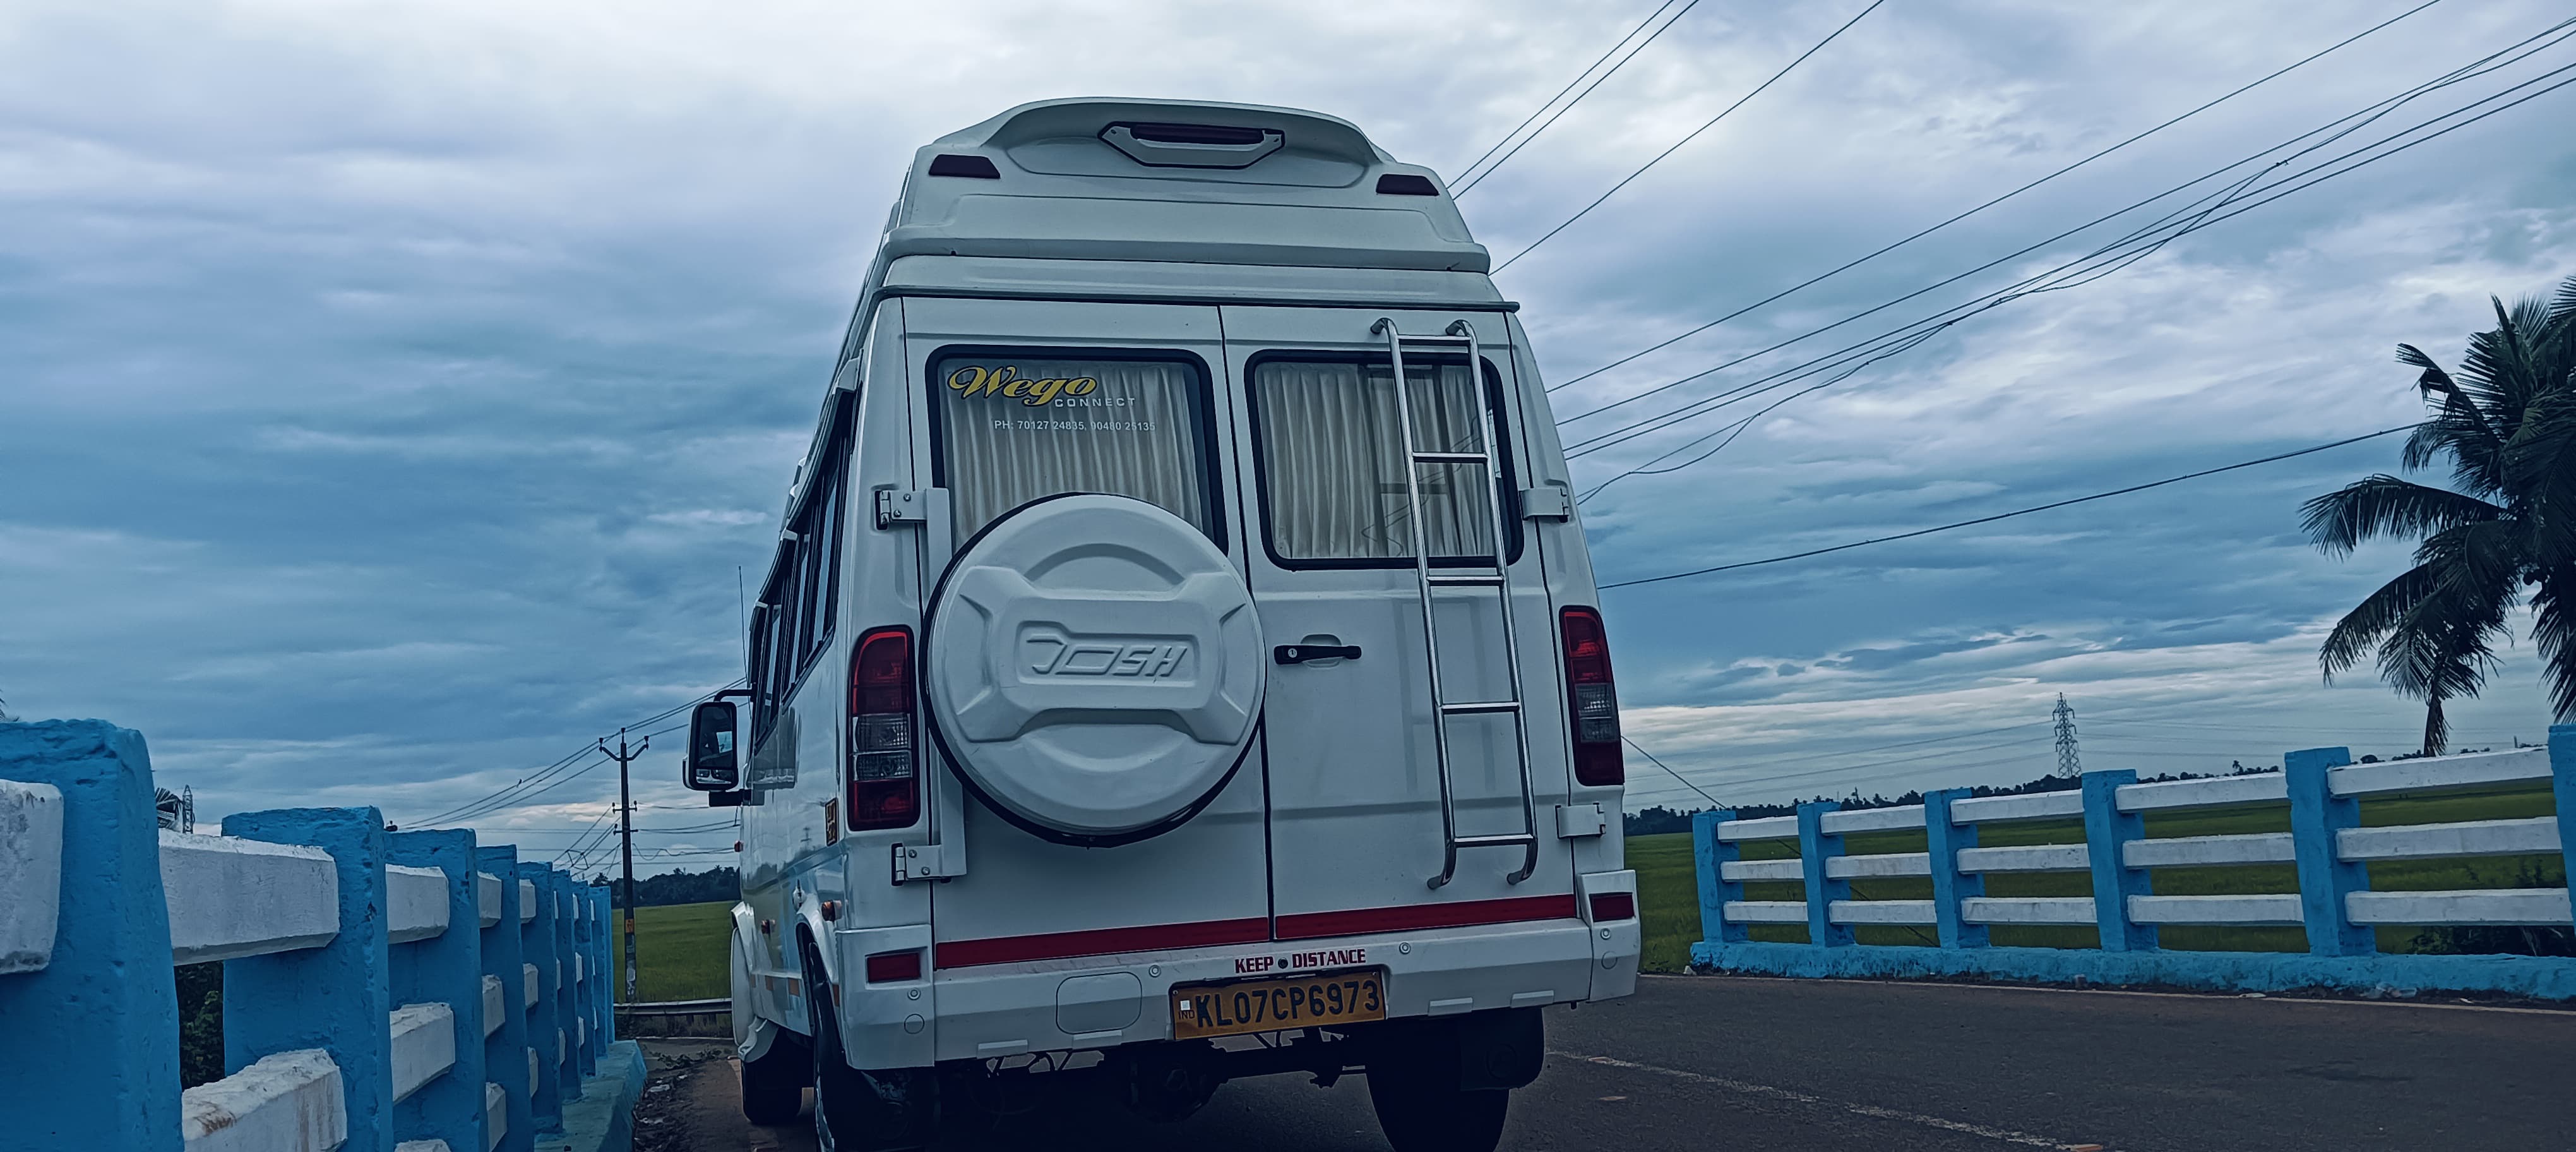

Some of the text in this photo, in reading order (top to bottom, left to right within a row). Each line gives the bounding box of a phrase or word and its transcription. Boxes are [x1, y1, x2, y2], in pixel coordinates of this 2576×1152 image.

[947, 366, 1097, 406] Wego
[1054, 398, 1135, 407] CONNECT
[994, 420, 1013, 430] PH:
[1017, 421, 1048, 430] 70127
[1026, 633, 1188, 677] JOSH
[1235, 949, 1366, 973] KEEP DISTANCE
[1179, 1009, 1195, 1020] IND
[1196, 980, 1380, 1028] KL07CP6973
